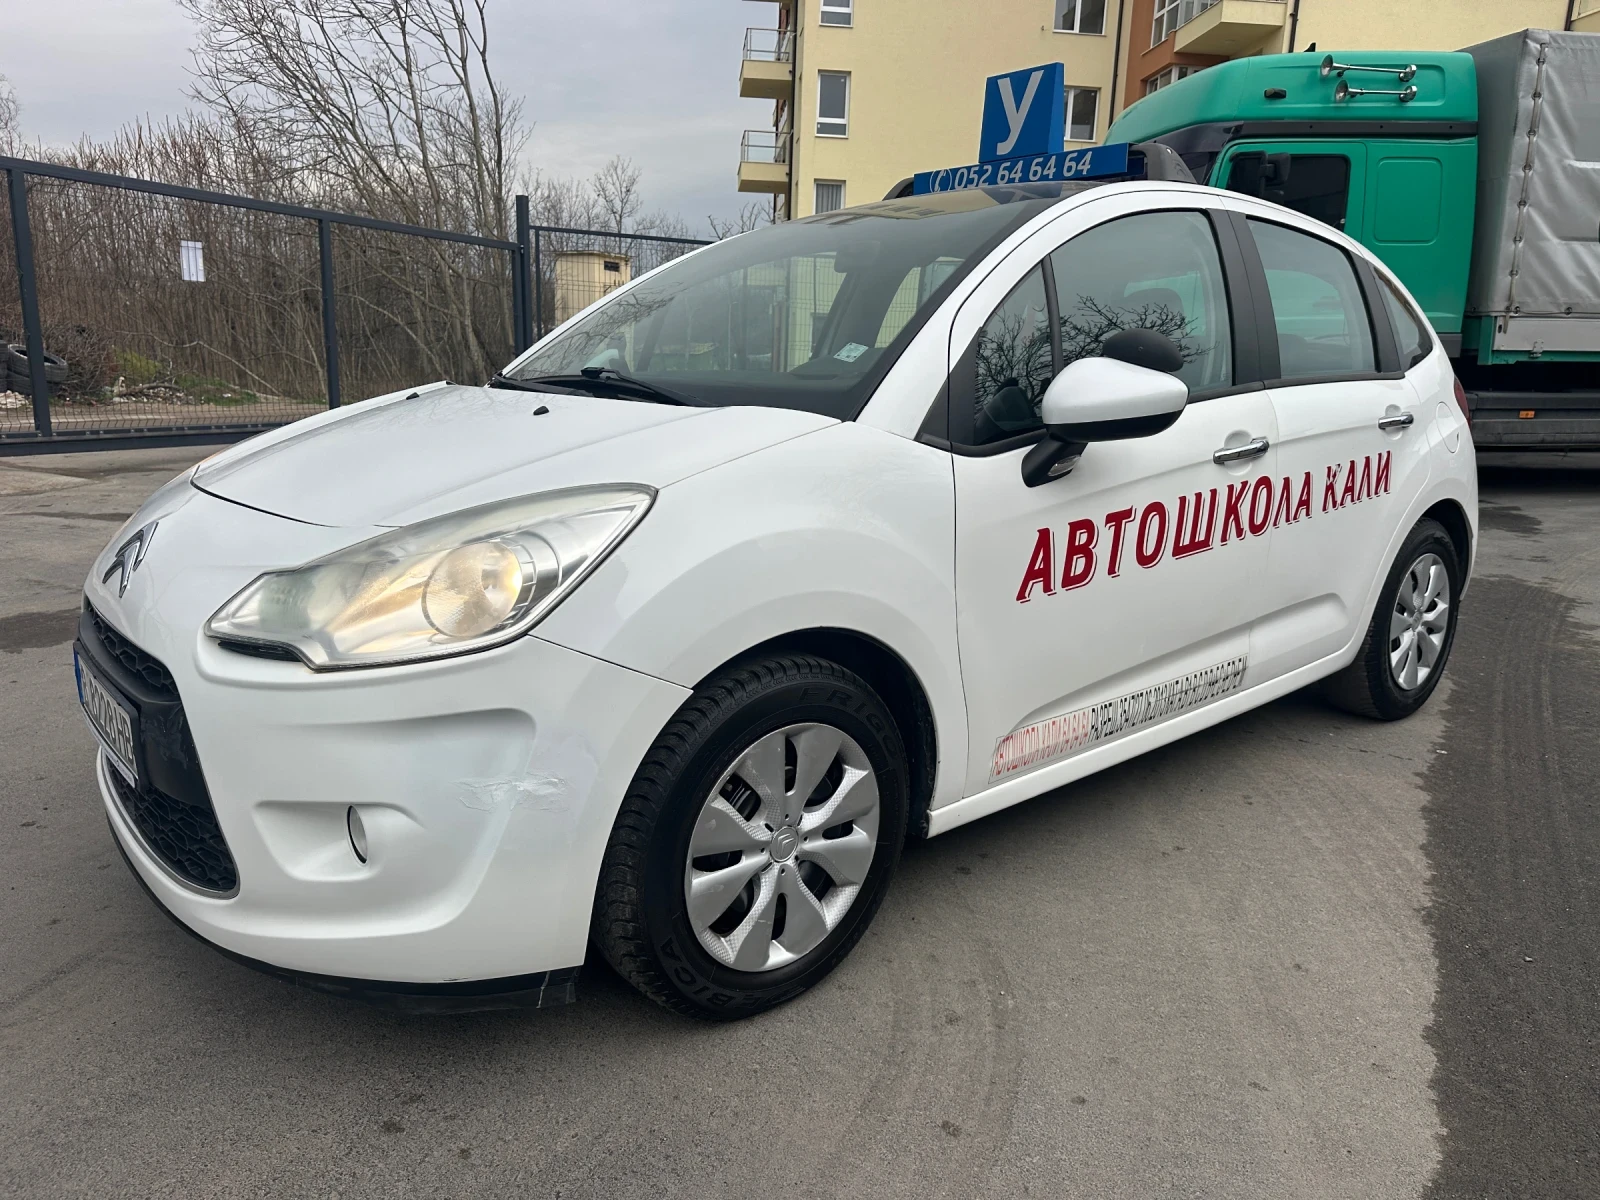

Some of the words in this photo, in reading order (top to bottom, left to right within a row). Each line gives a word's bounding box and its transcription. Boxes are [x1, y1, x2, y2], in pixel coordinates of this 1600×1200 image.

[954, 164, 992, 190] 052
[996, 160, 1024, 185] 64
[1029, 155, 1056, 182] 64
[1062, 151, 1093, 177] 64
[1016, 471, 1313, 604] АВТОШКОЛА
[1321, 450, 1393, 513] КАЛИ
[799, 687, 898, 759] FRIGO
